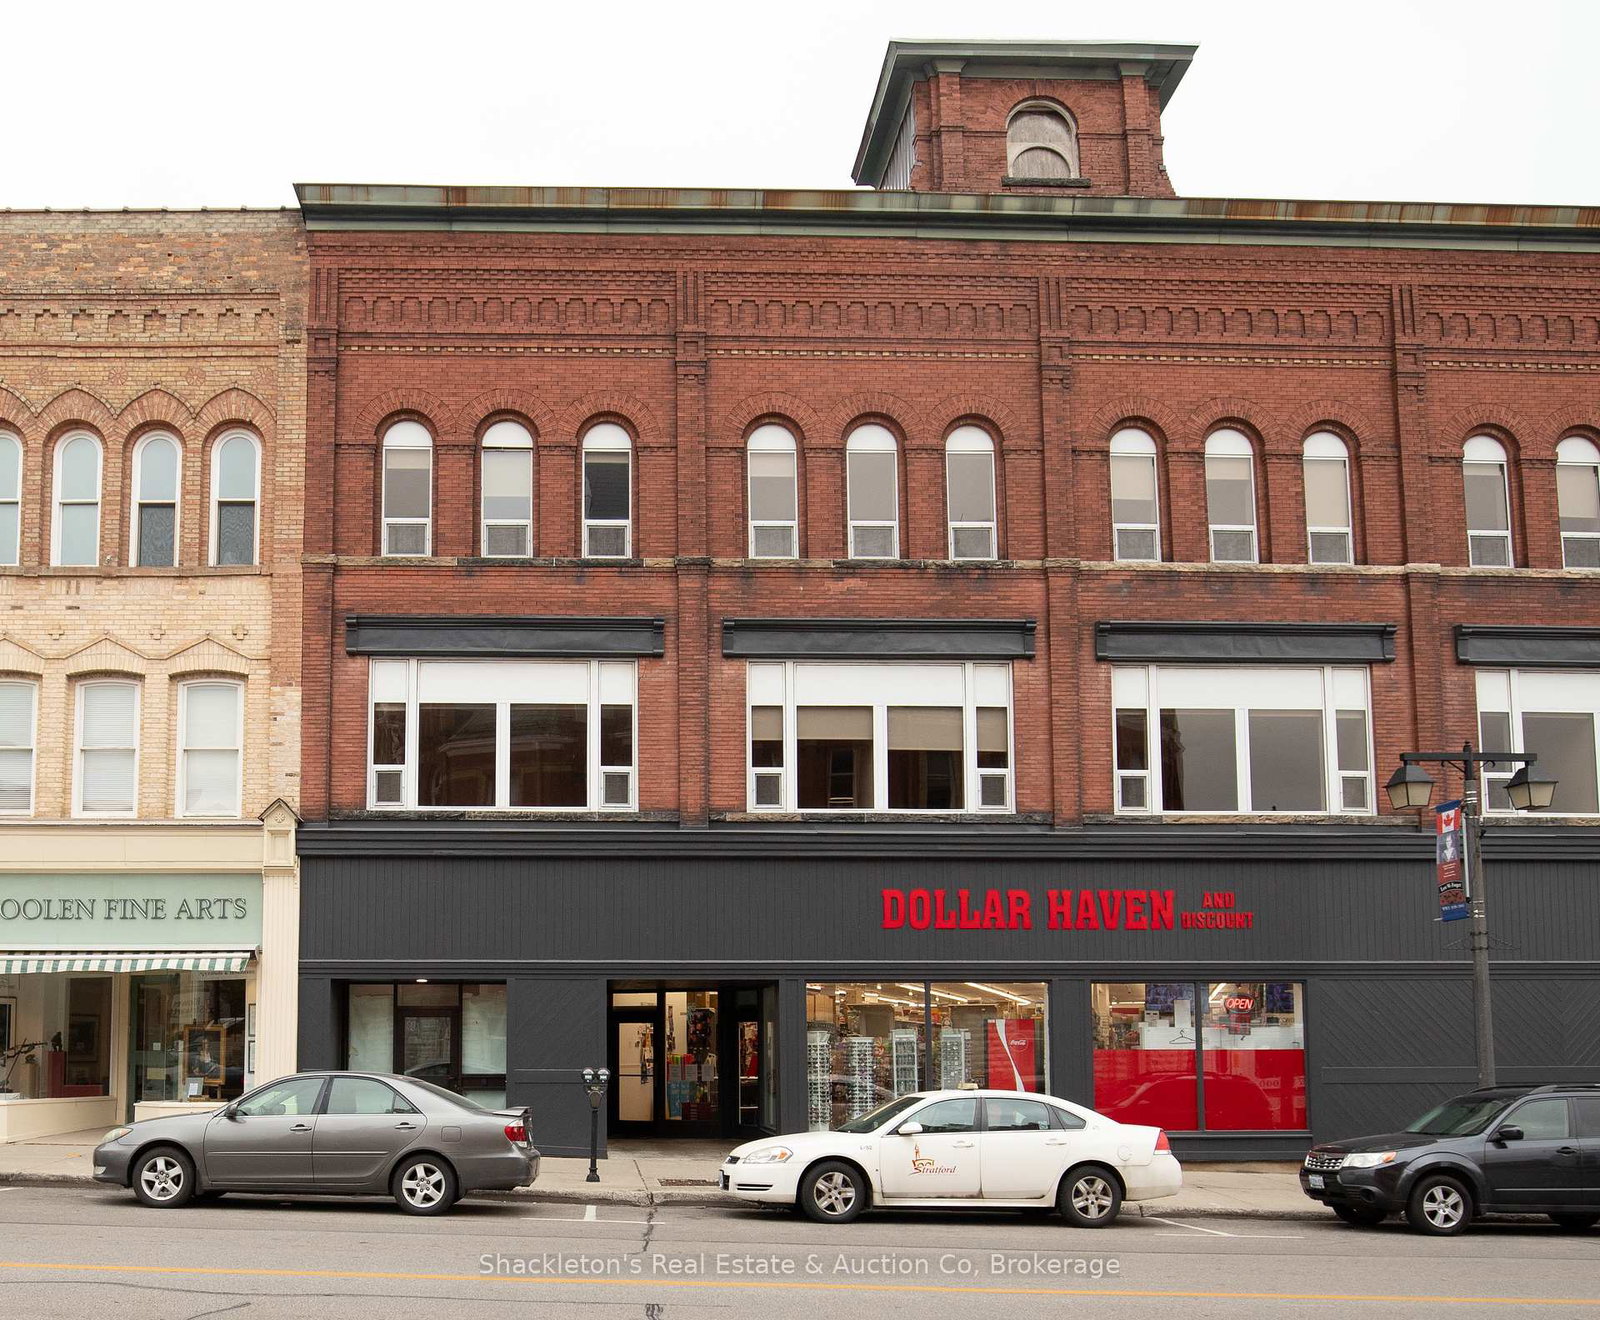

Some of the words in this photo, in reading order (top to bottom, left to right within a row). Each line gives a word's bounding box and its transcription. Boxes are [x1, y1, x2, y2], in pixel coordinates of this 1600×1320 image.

[0, 898, 96, 920] OOLEN
[104, 898, 167, 920] FINE
[174, 898, 247, 920] ARTS
[1202, 892, 1235, 909] AND
[881, 889, 1032, 930] DOLLAR
[1047, 889, 1175, 930] HAVEN
[1181, 911, 1253, 929] DISCOUNT
[1227, 999, 1253, 1009] OPEN
[908, 1165, 957, 1176] Stratford
